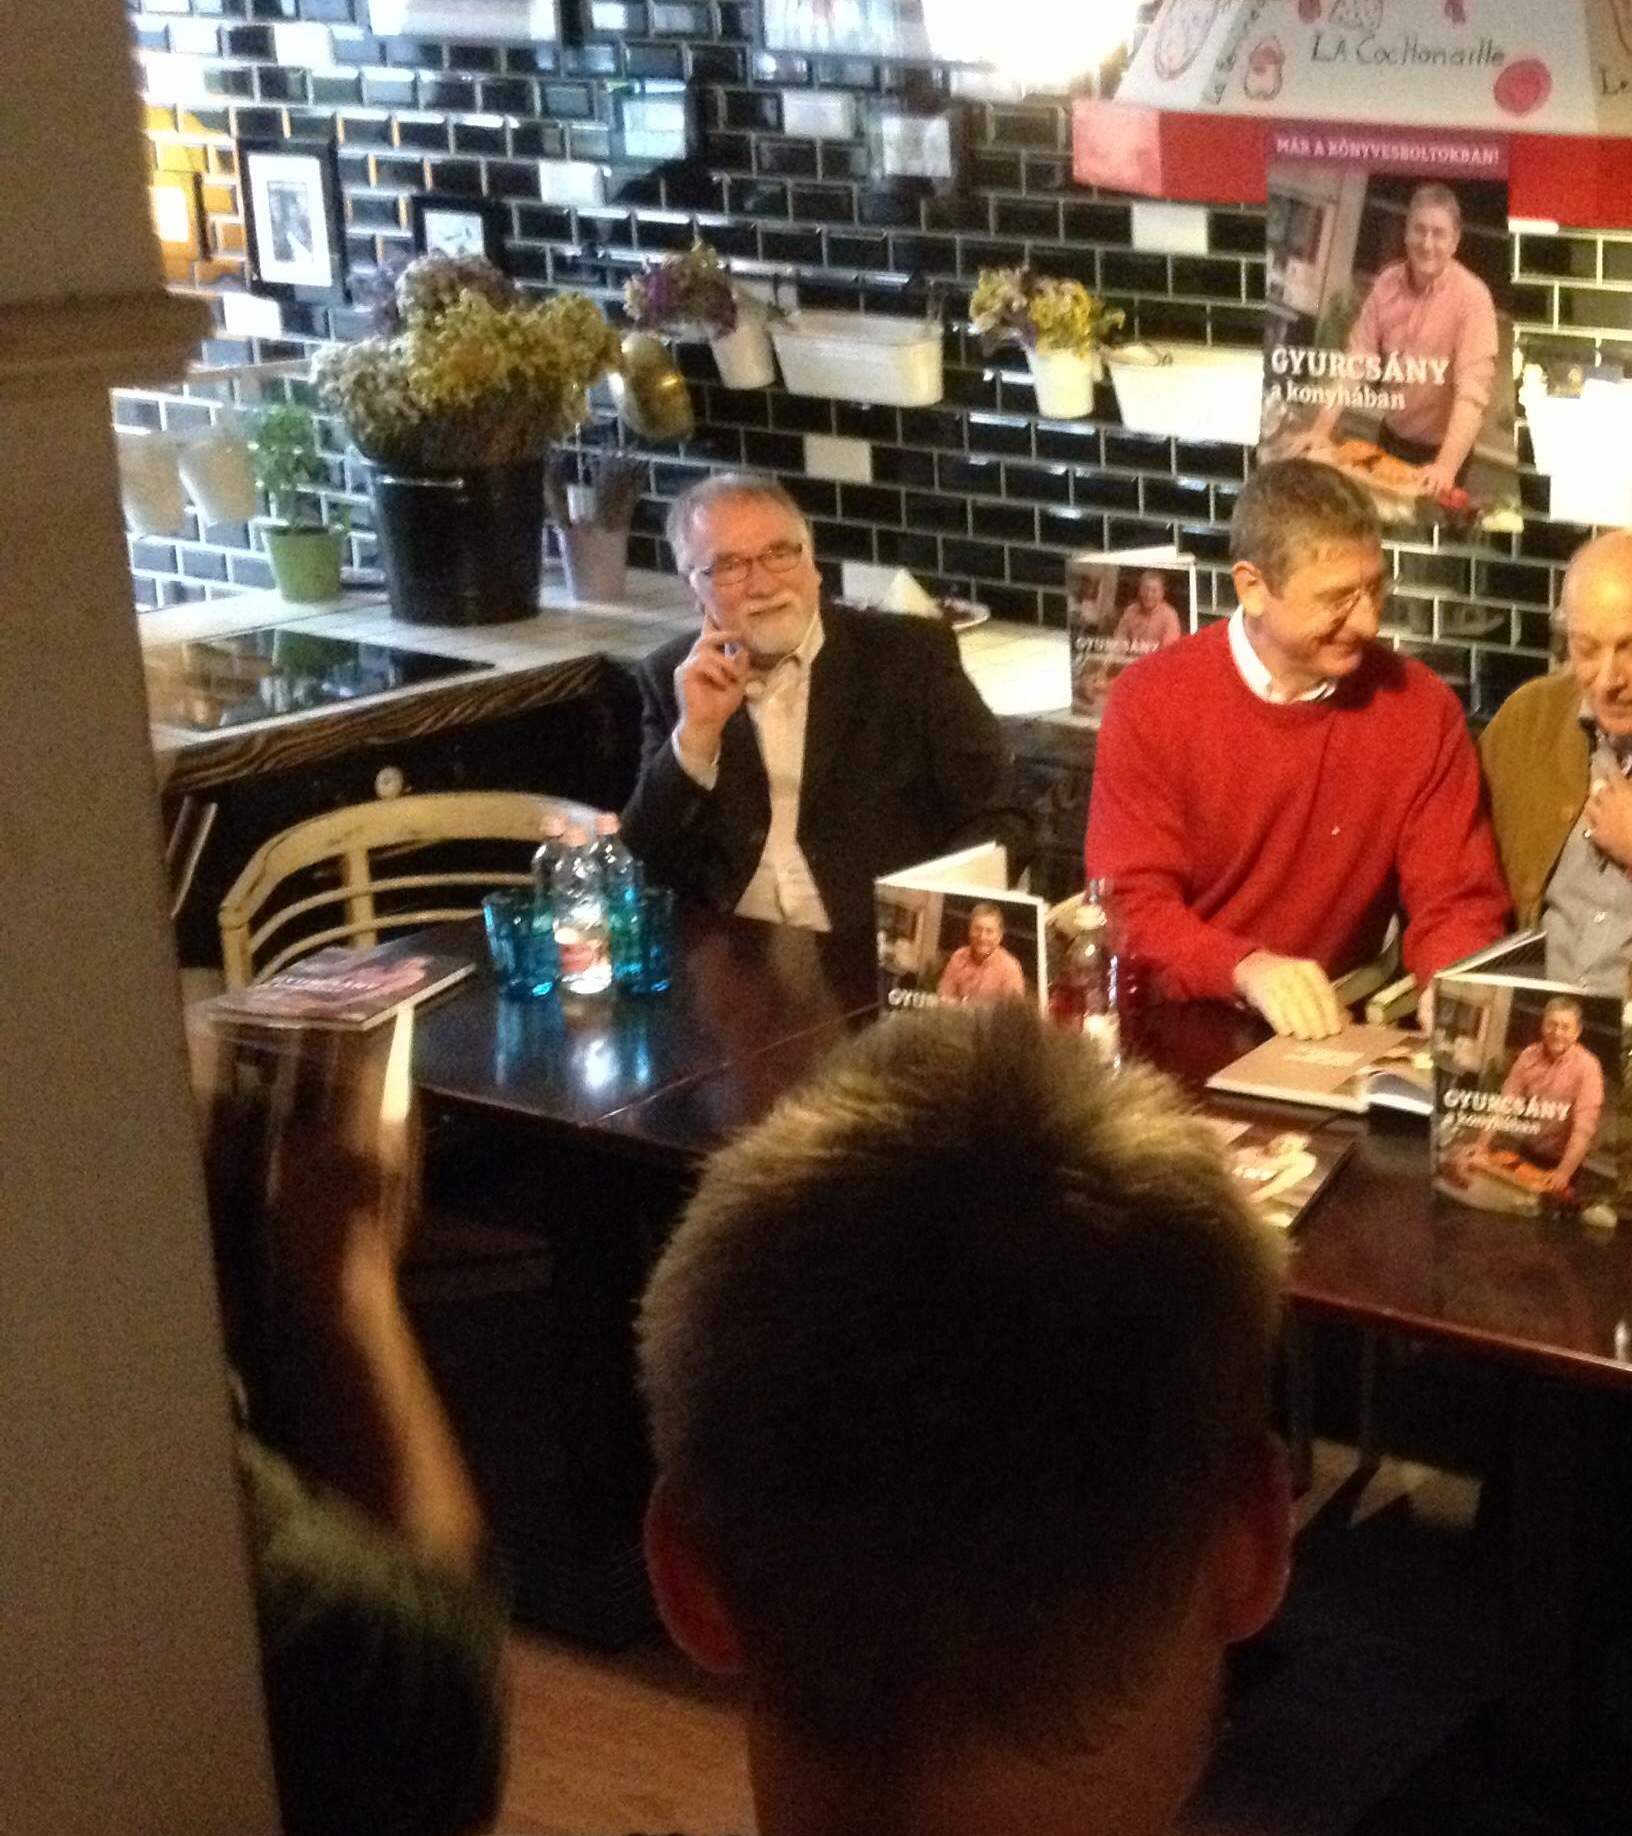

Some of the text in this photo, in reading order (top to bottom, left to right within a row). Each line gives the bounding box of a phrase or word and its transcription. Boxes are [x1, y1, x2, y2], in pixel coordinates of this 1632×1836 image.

[1311, 33, 1347, 62] LA
[1313, 139, 1325, 157] A
[1270, 345, 1451, 386] GYURCSÁNY
[1443, 1088, 1573, 1122] GYURCSÁNY
